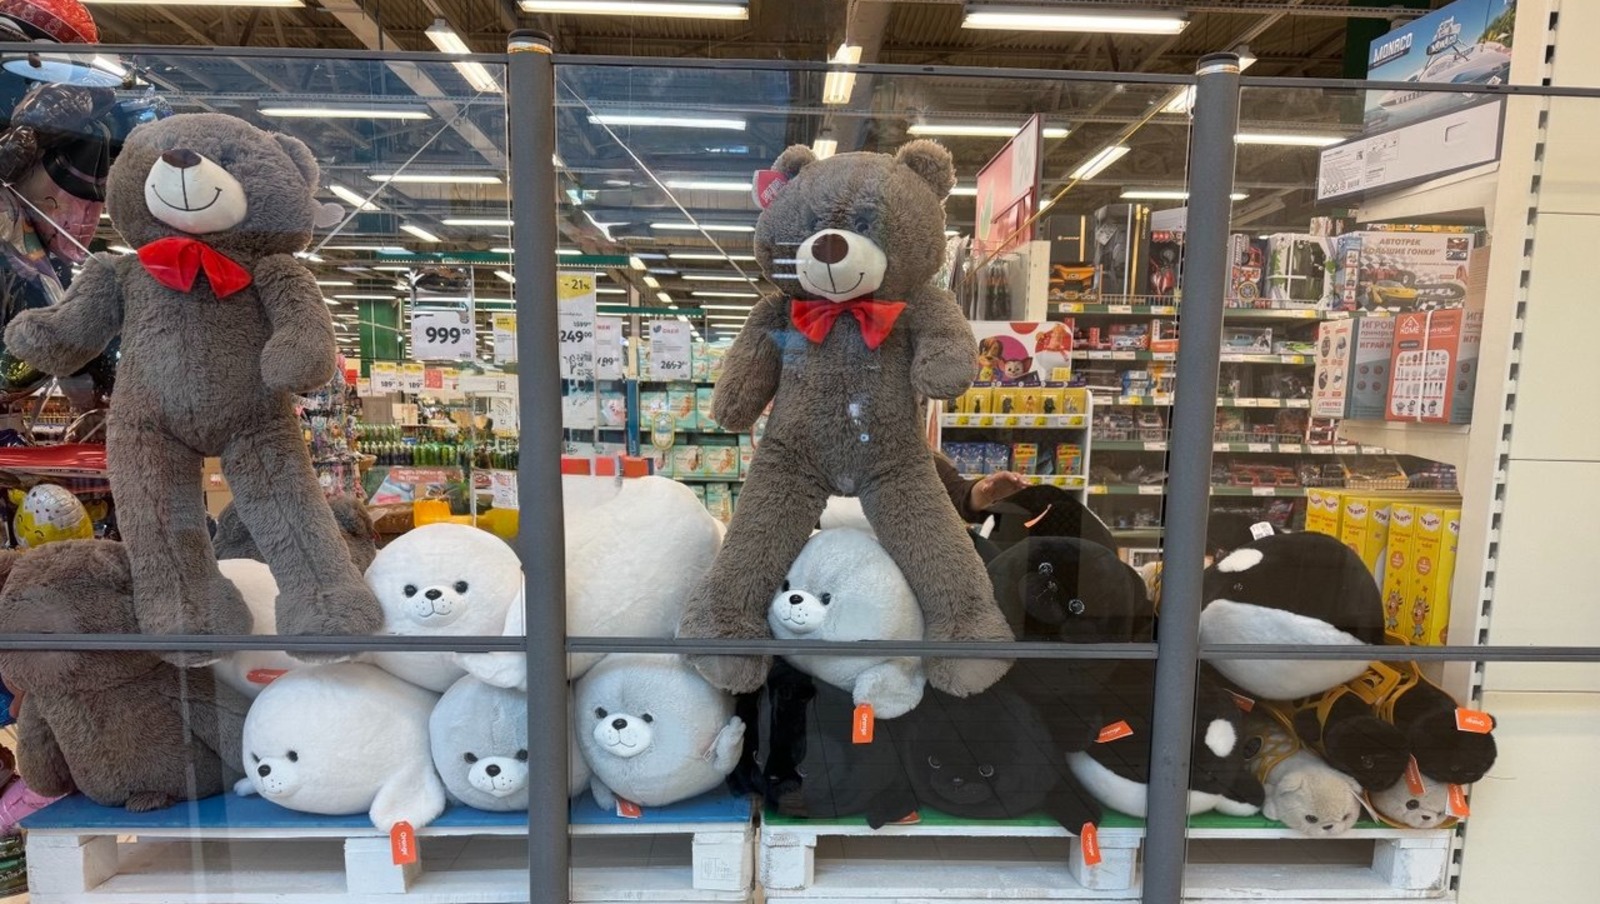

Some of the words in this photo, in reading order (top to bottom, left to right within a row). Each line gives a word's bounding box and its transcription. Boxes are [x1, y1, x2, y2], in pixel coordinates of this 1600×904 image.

[1374, 32, 1412, 62] MONACO
[425, 326, 461, 344] 999
[1087, 833, 1095, 856] Orange
